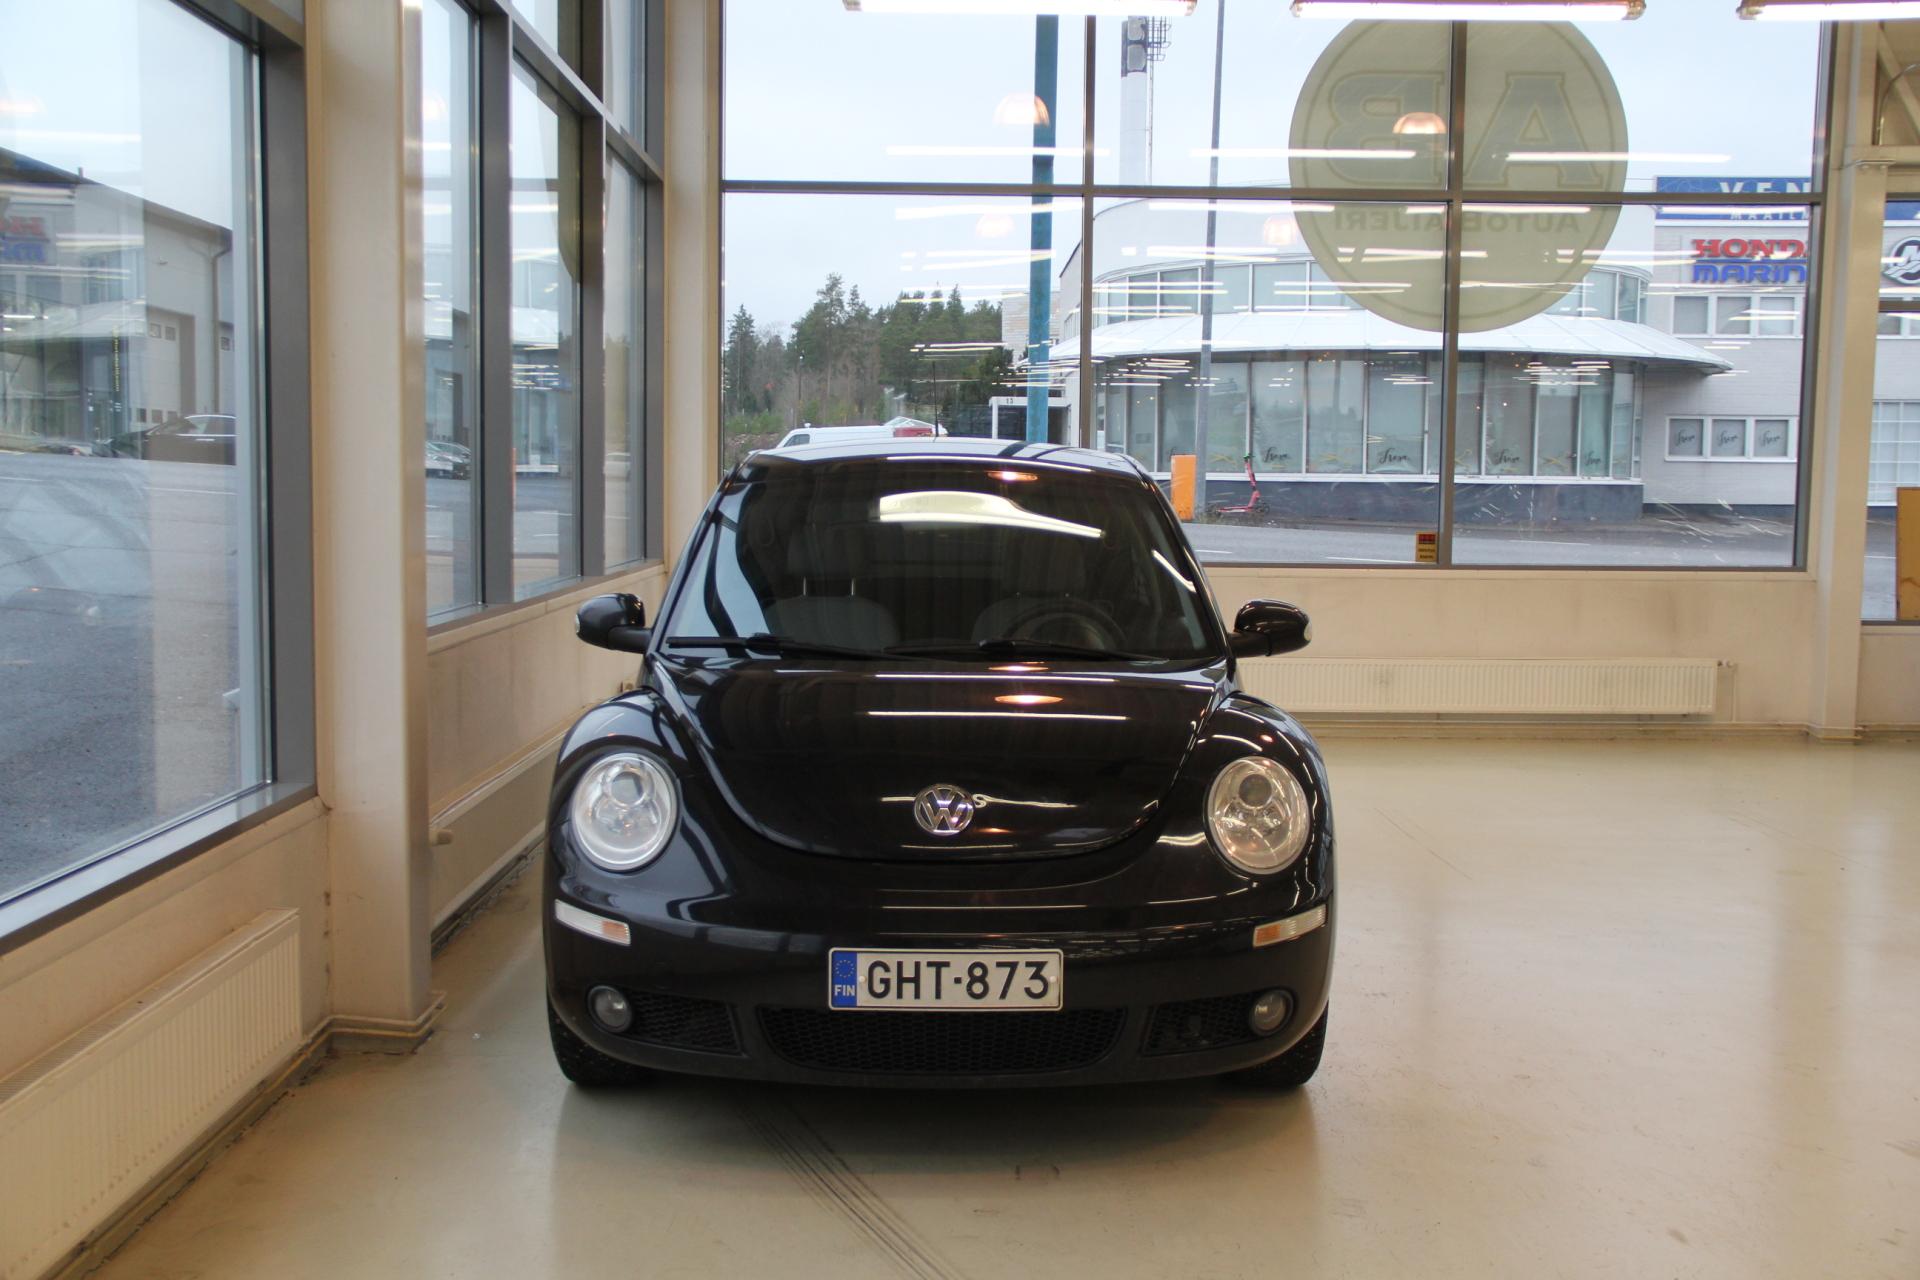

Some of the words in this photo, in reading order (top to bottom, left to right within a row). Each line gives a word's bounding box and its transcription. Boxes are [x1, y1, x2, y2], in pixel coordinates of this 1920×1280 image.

[1691, 238, 1808, 257] HOND
[868, 960, 1049, 1000] GHT-873
[834, 985, 855, 997] FIN
